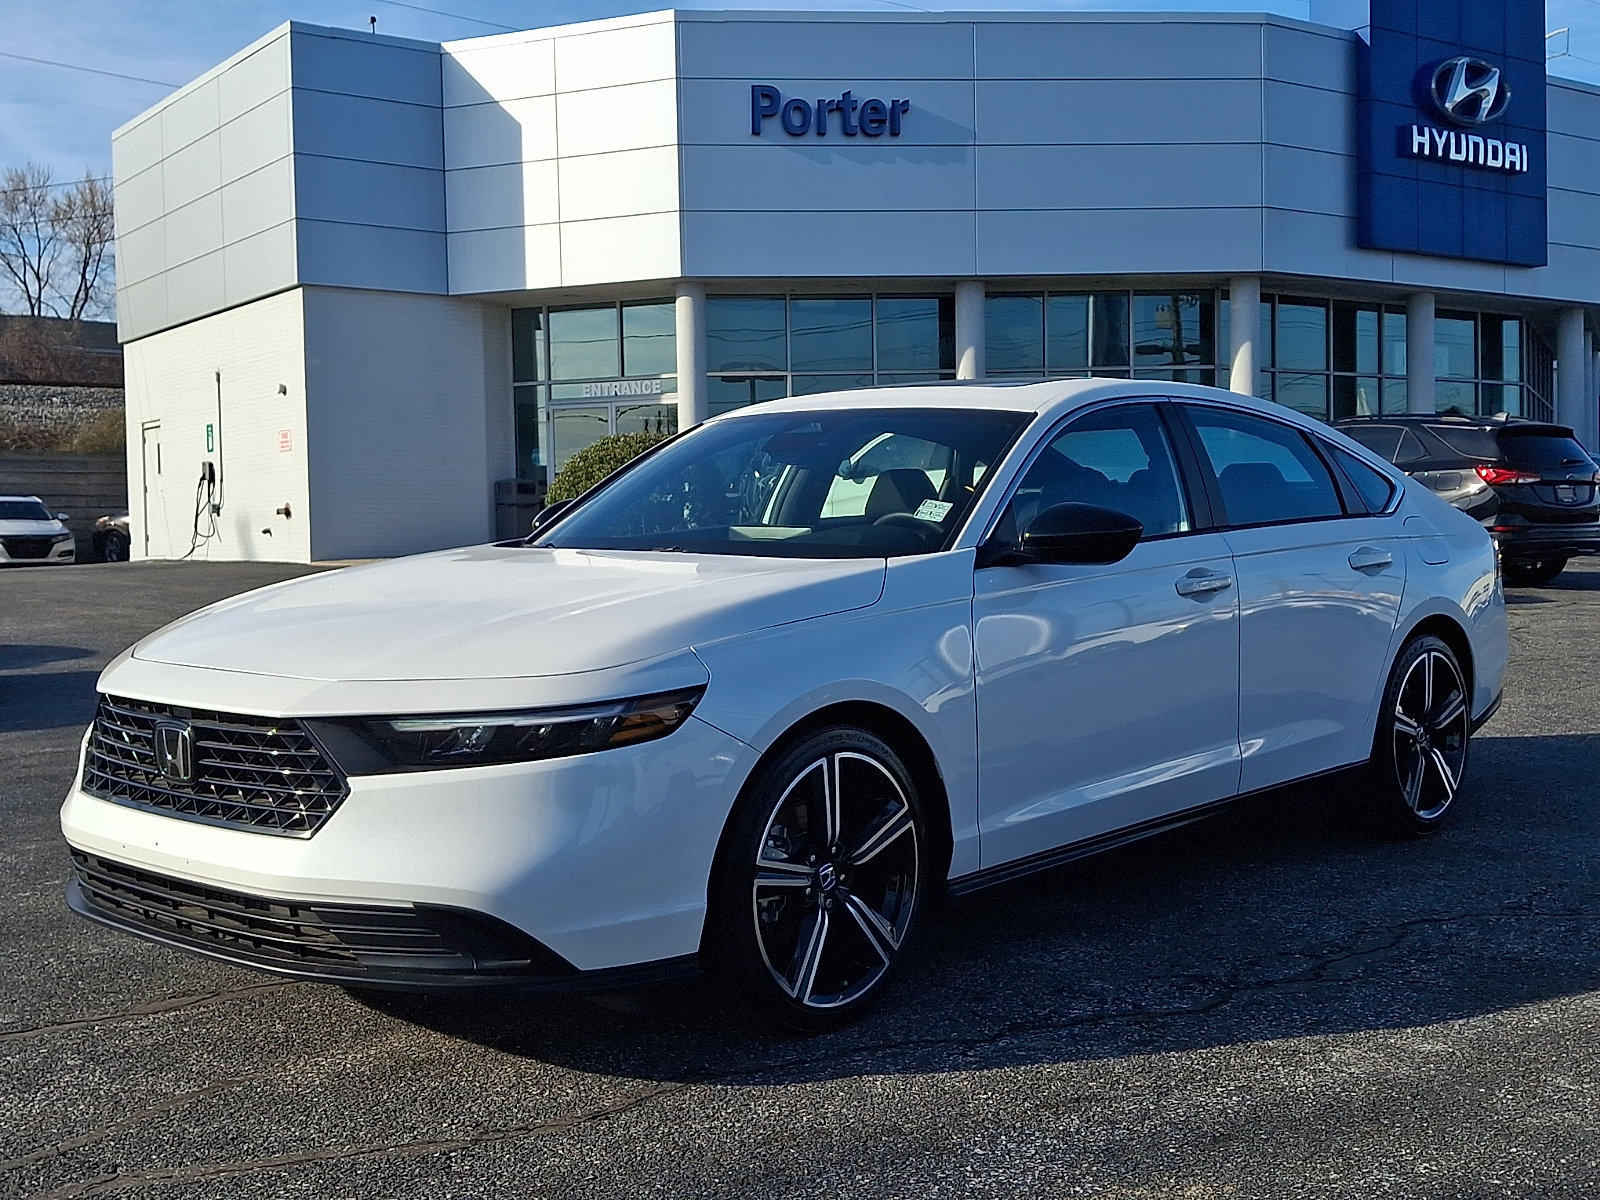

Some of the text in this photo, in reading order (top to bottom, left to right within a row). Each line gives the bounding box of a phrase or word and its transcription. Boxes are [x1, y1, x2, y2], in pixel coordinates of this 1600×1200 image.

[751, 84, 910, 137] Porter
[1412, 124, 1528, 172] HYUNDAI
[582, 380, 662, 398] ENTRANCE
